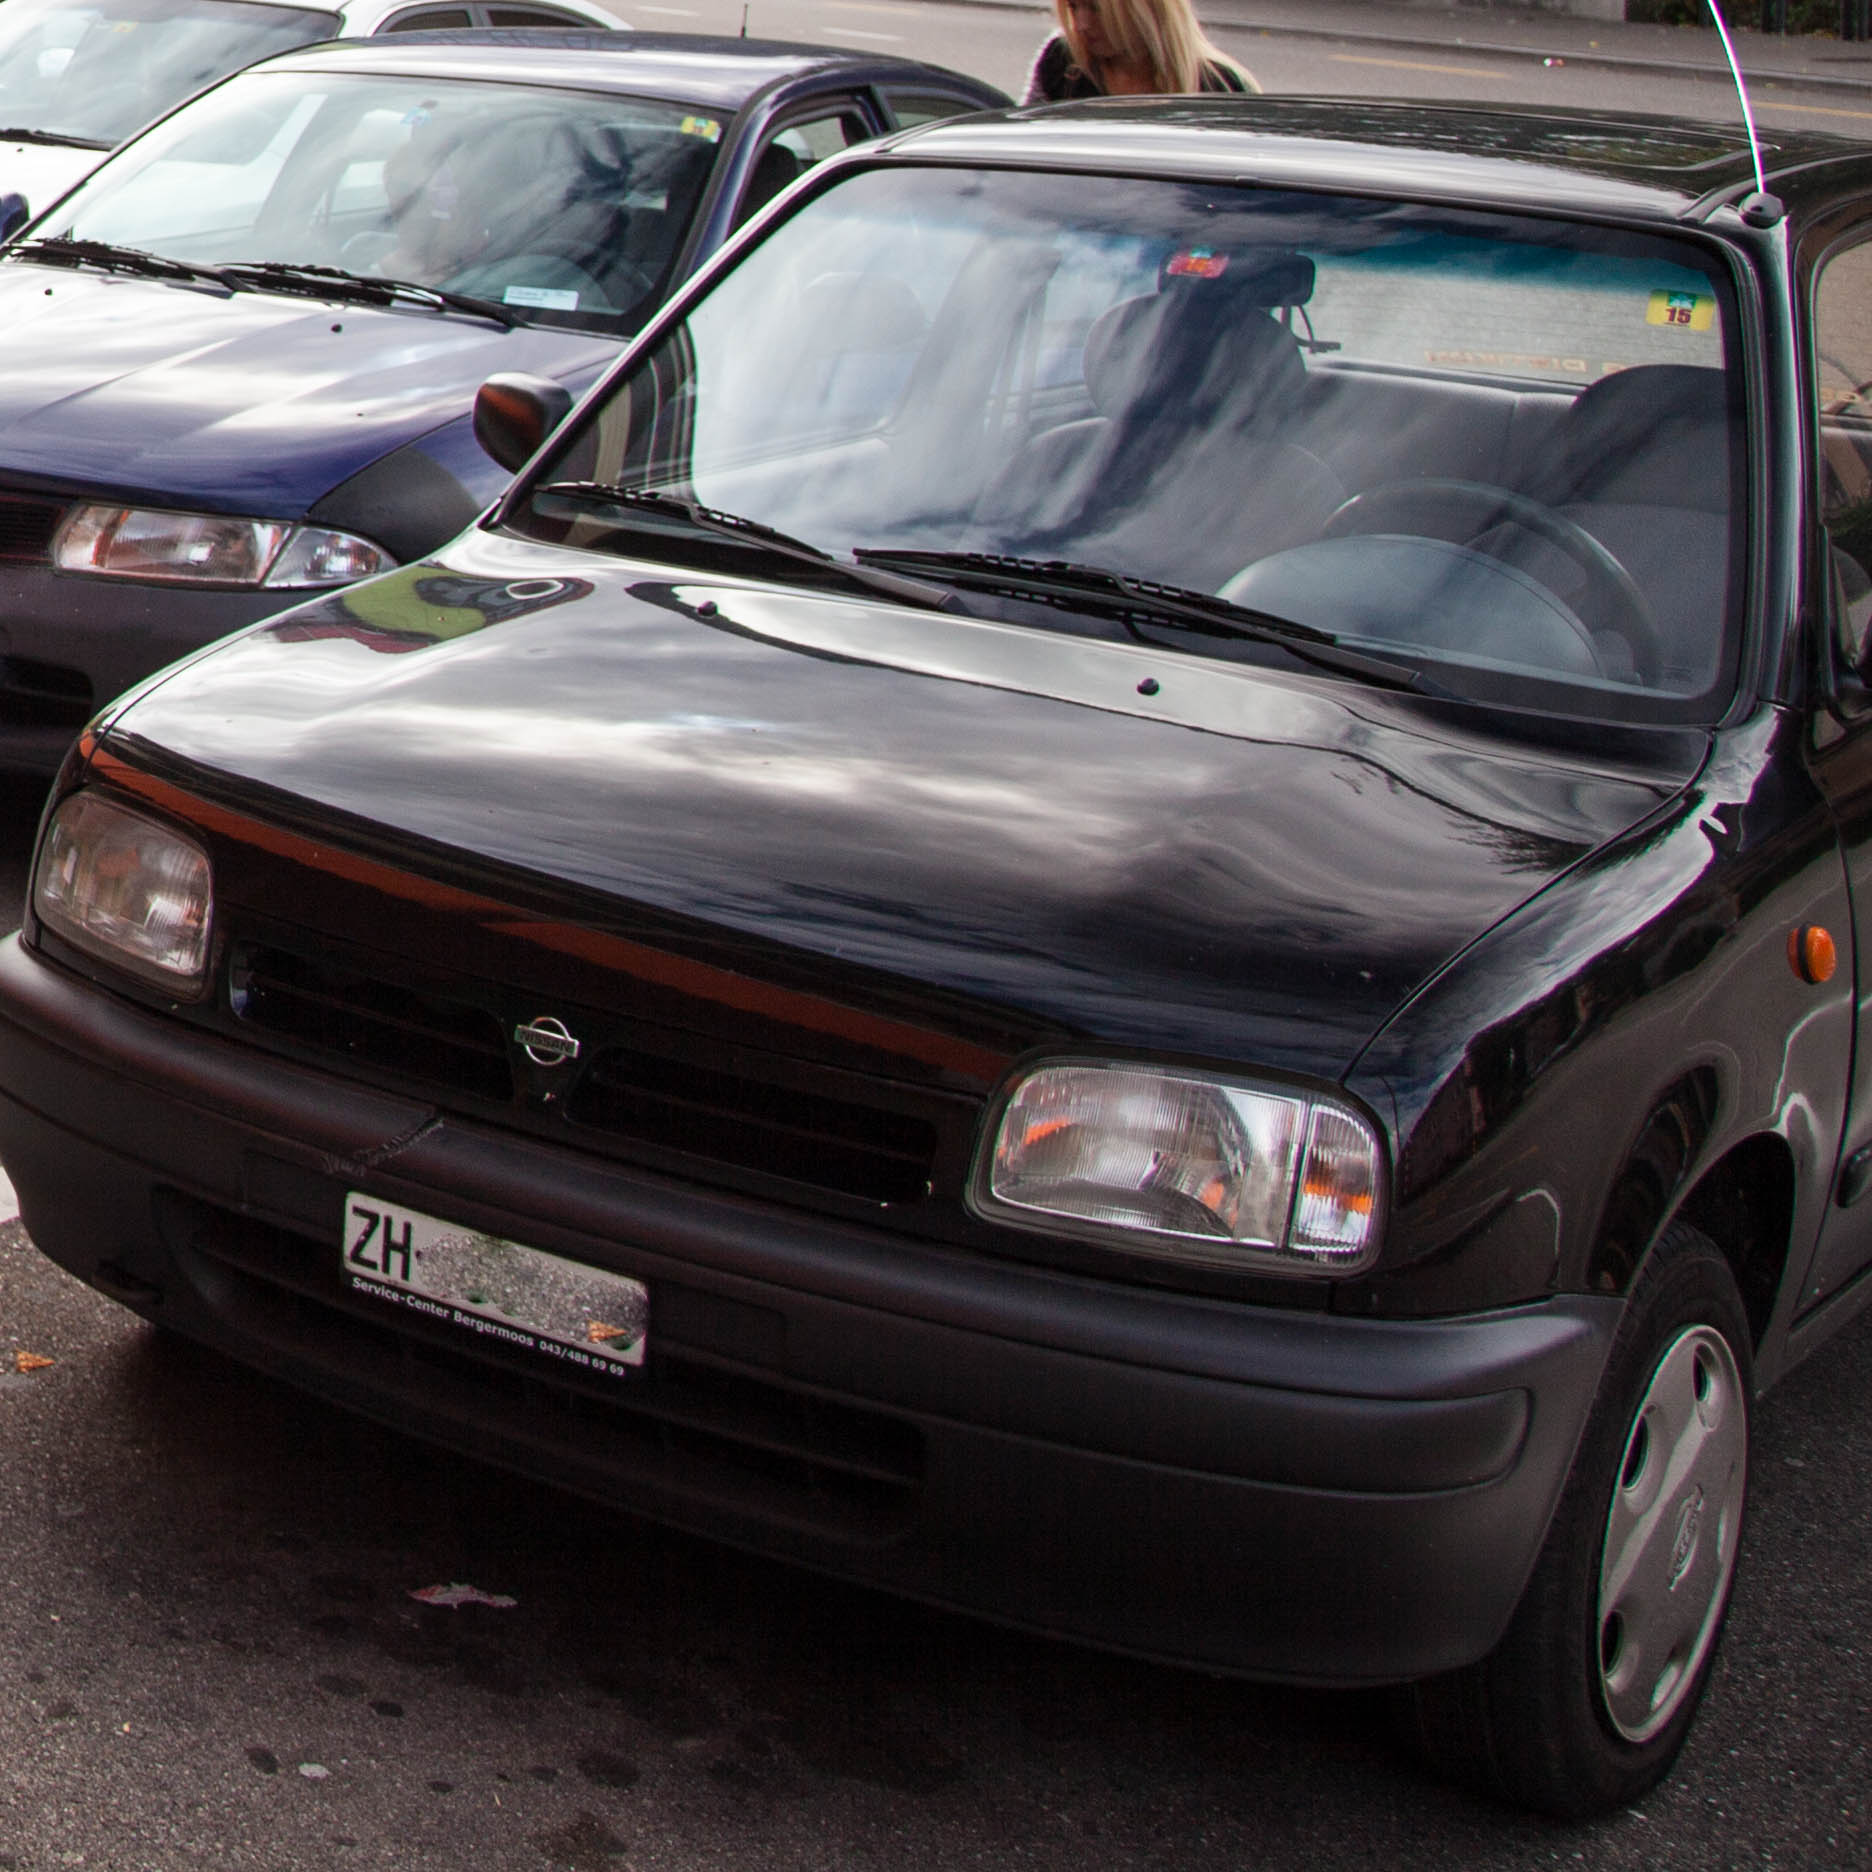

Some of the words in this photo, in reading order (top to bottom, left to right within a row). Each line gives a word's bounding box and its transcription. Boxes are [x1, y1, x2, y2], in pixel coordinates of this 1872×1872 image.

[1665, 306, 1692, 324] 15
[350, 1206, 413, 1281] ZH
[352, 1278, 450, 1319] Service-Center
[453, 1310, 535, 1347] Bergermoos
[539, 1340, 589, 1365] 043/488
[592, 1355, 606, 1371] 69
[609, 1362, 625, 1377] 69
